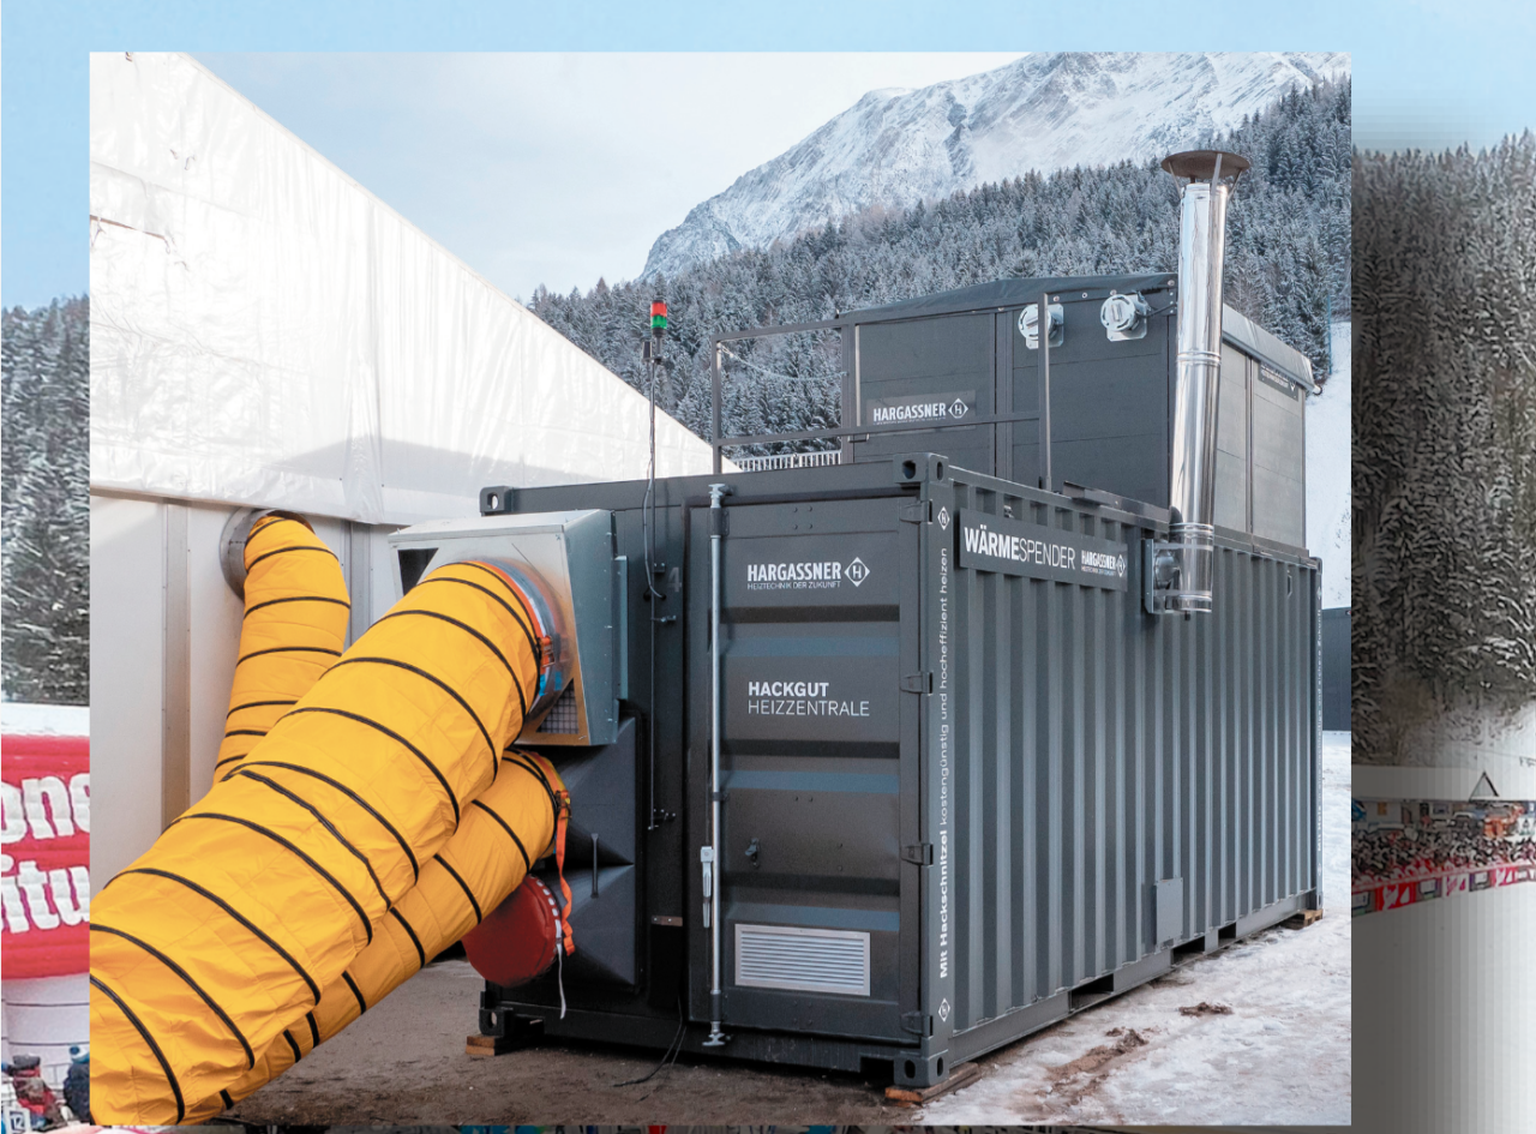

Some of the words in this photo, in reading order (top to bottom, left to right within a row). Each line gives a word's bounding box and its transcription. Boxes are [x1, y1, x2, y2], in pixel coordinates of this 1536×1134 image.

[873, 403, 946, 422] HARGASSNER
[964, 524, 1076, 570] WÄRMESPENDER
[747, 562, 842, 582] HARGASSNER
[940, 547, 948, 594] heizen
[793, 581, 807, 589] DER
[808, 580, 841, 589] ZUKUNFT
[940, 597, 948, 689] hocheffizient
[748, 681, 830, 697] HACKGUT
[748, 700, 870, 717] HEIZZENTRALE
[940, 694, 948, 720] und
[939, 724, 950, 826] kostengünstig
[940, 830, 948, 947] Hackschnitzel
[940, 950, 948, 979] Mit
